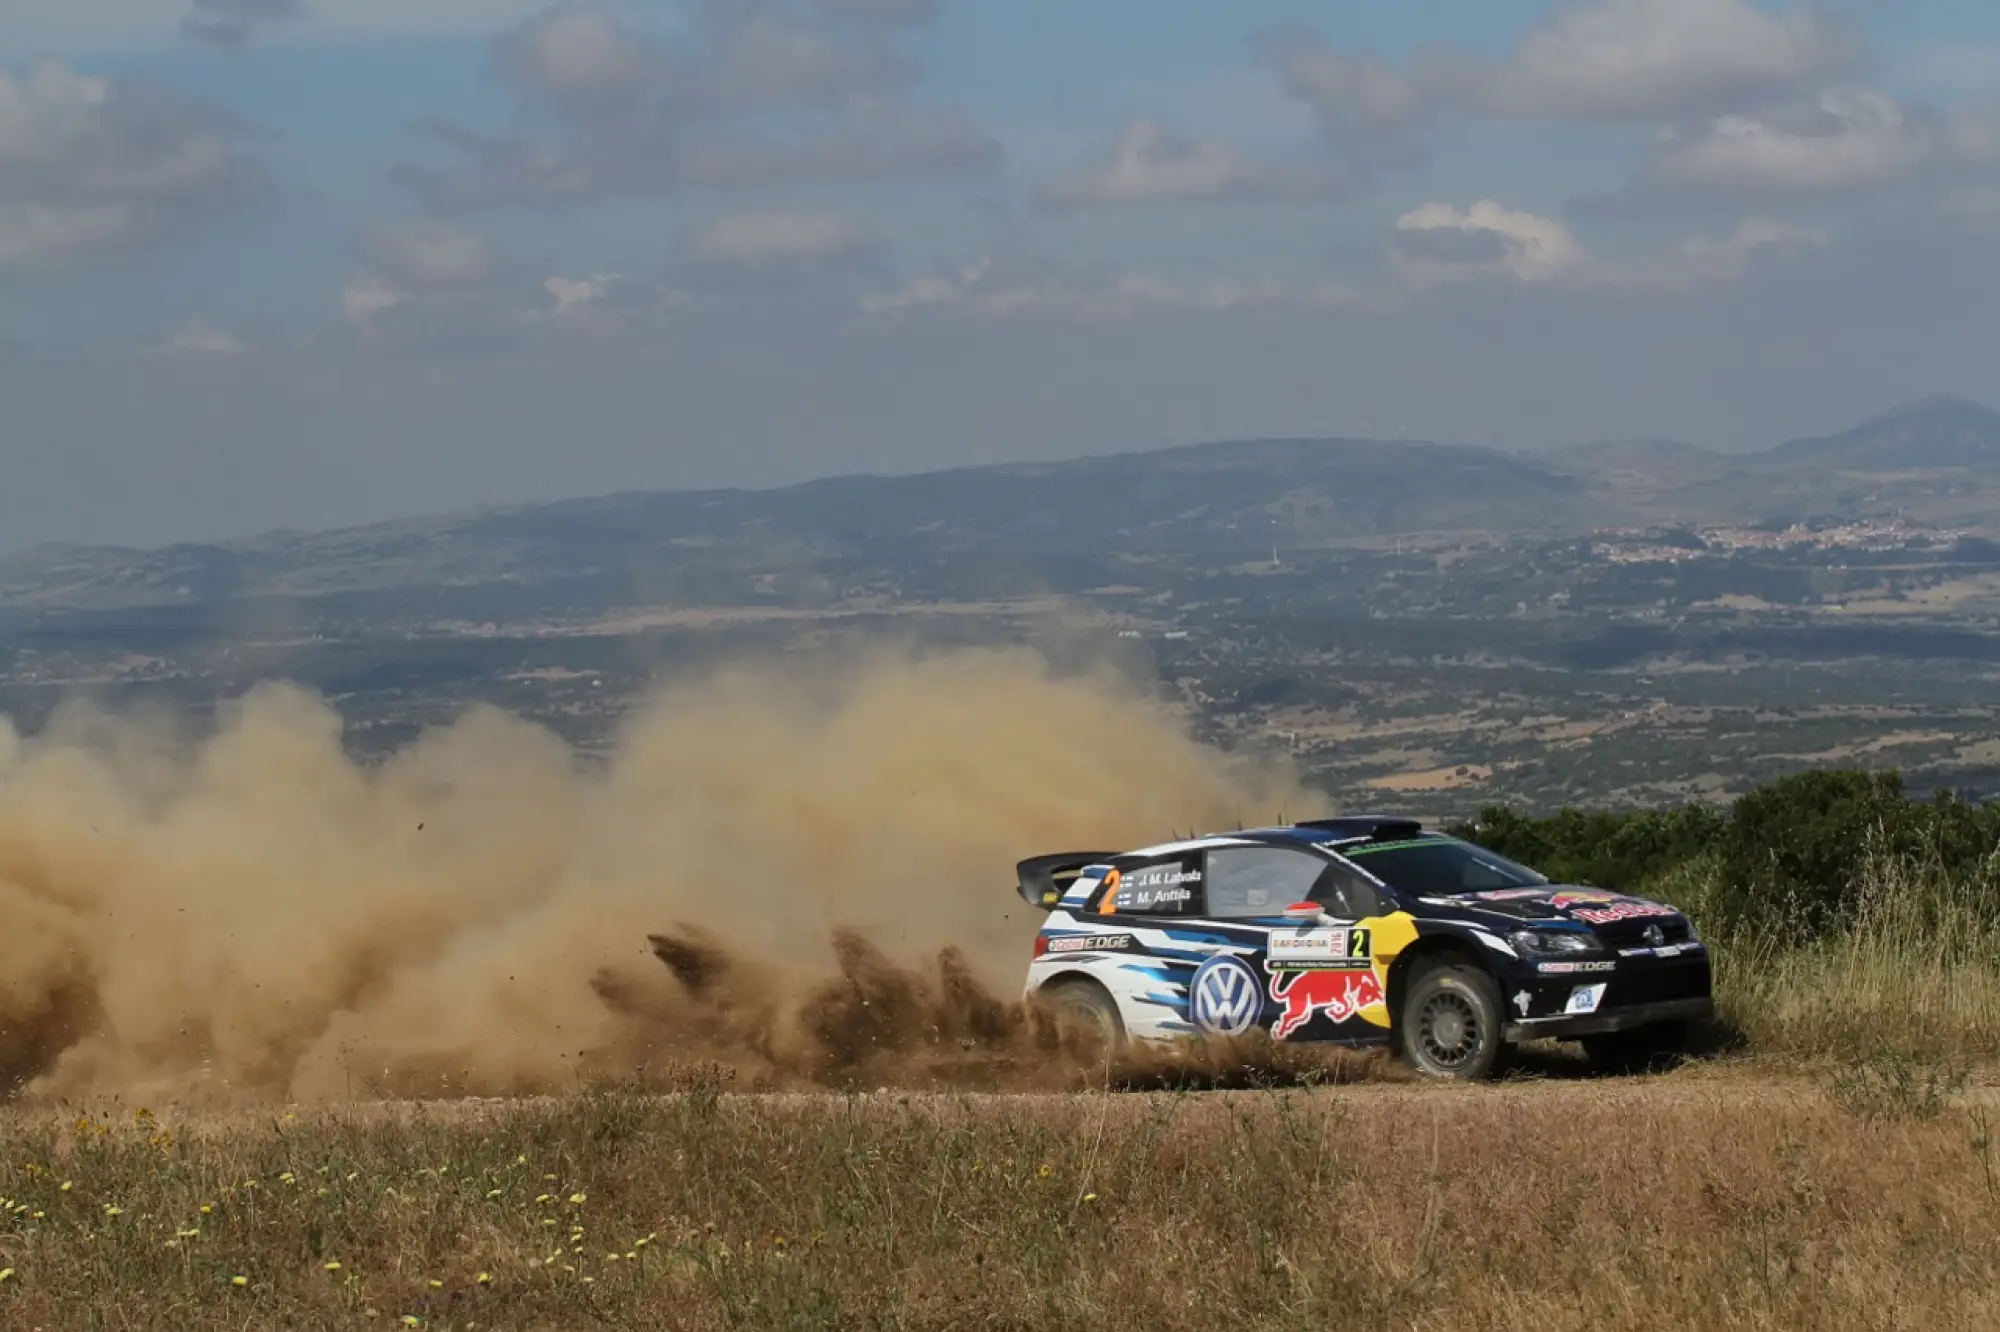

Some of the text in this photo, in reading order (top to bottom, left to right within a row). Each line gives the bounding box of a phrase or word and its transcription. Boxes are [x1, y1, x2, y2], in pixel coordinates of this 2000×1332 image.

[1100, 869, 1120, 914] 2
[1084, 935, 1131, 949] EDGE
[1352, 930, 1364, 957] 2
